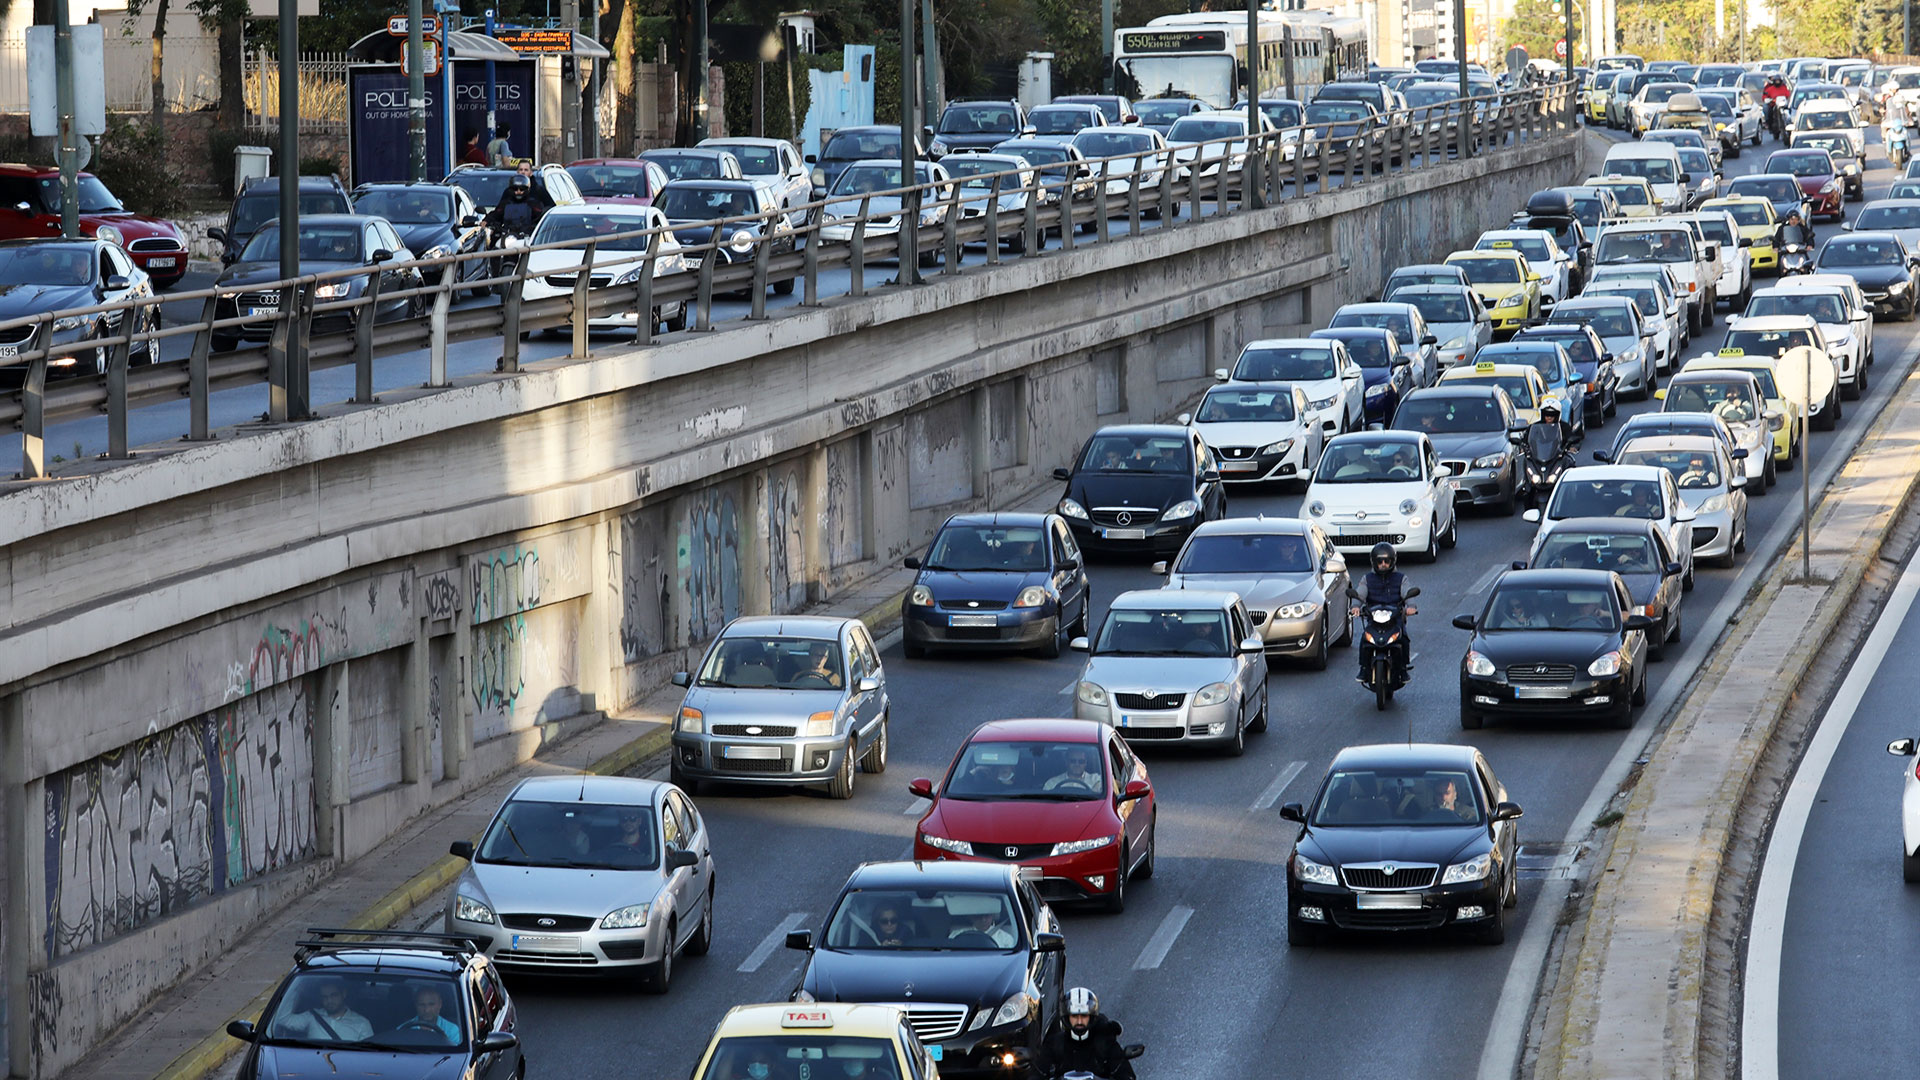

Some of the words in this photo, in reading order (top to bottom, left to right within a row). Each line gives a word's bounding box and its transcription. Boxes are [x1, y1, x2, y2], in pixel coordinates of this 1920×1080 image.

[1127, 34, 1148, 48] 550
[456, 84, 520, 100] POLTIS
[365, 112, 379, 120] OUT
[380, 111, 390, 119] OF
